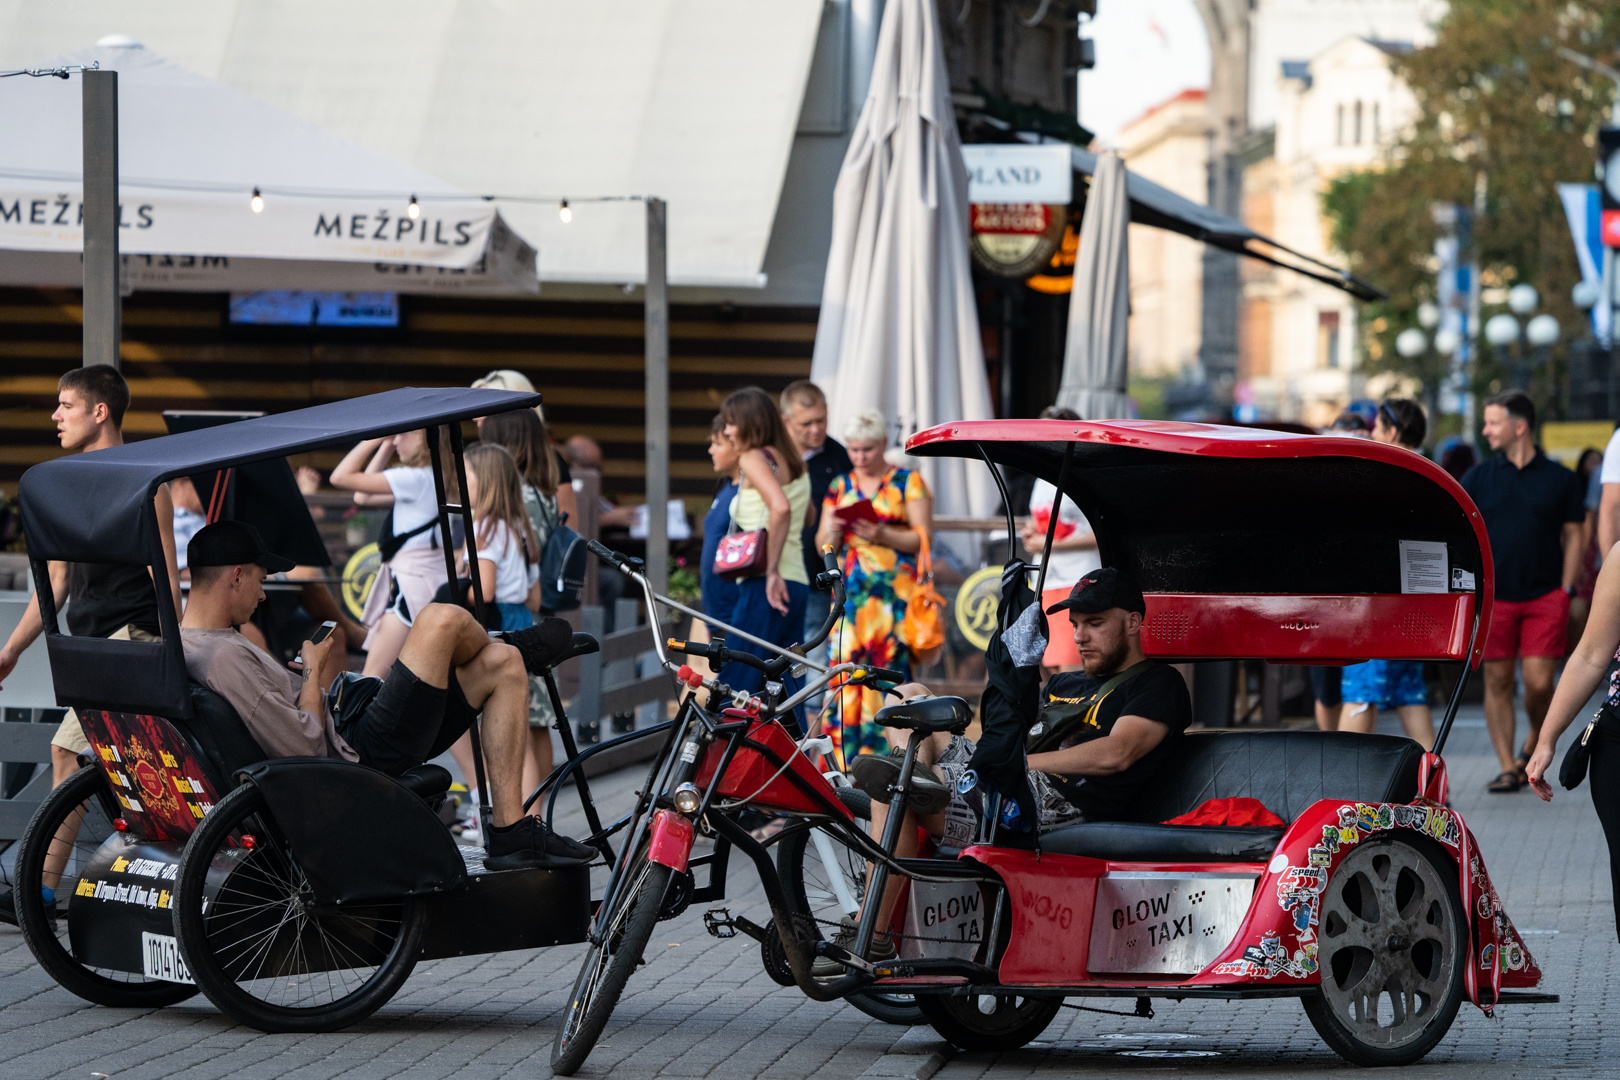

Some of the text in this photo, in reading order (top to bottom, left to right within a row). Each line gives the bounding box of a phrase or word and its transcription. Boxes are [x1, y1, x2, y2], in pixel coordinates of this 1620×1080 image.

[970, 166, 1041, 185] LAND
[0, 193, 154, 229] MEŽLS
[314, 208, 471, 246] MEŽPILS
[923, 890, 980, 927] GLOW
[1112, 892, 1170, 930] GLOW
[1147, 913, 1193, 947] TAXI
